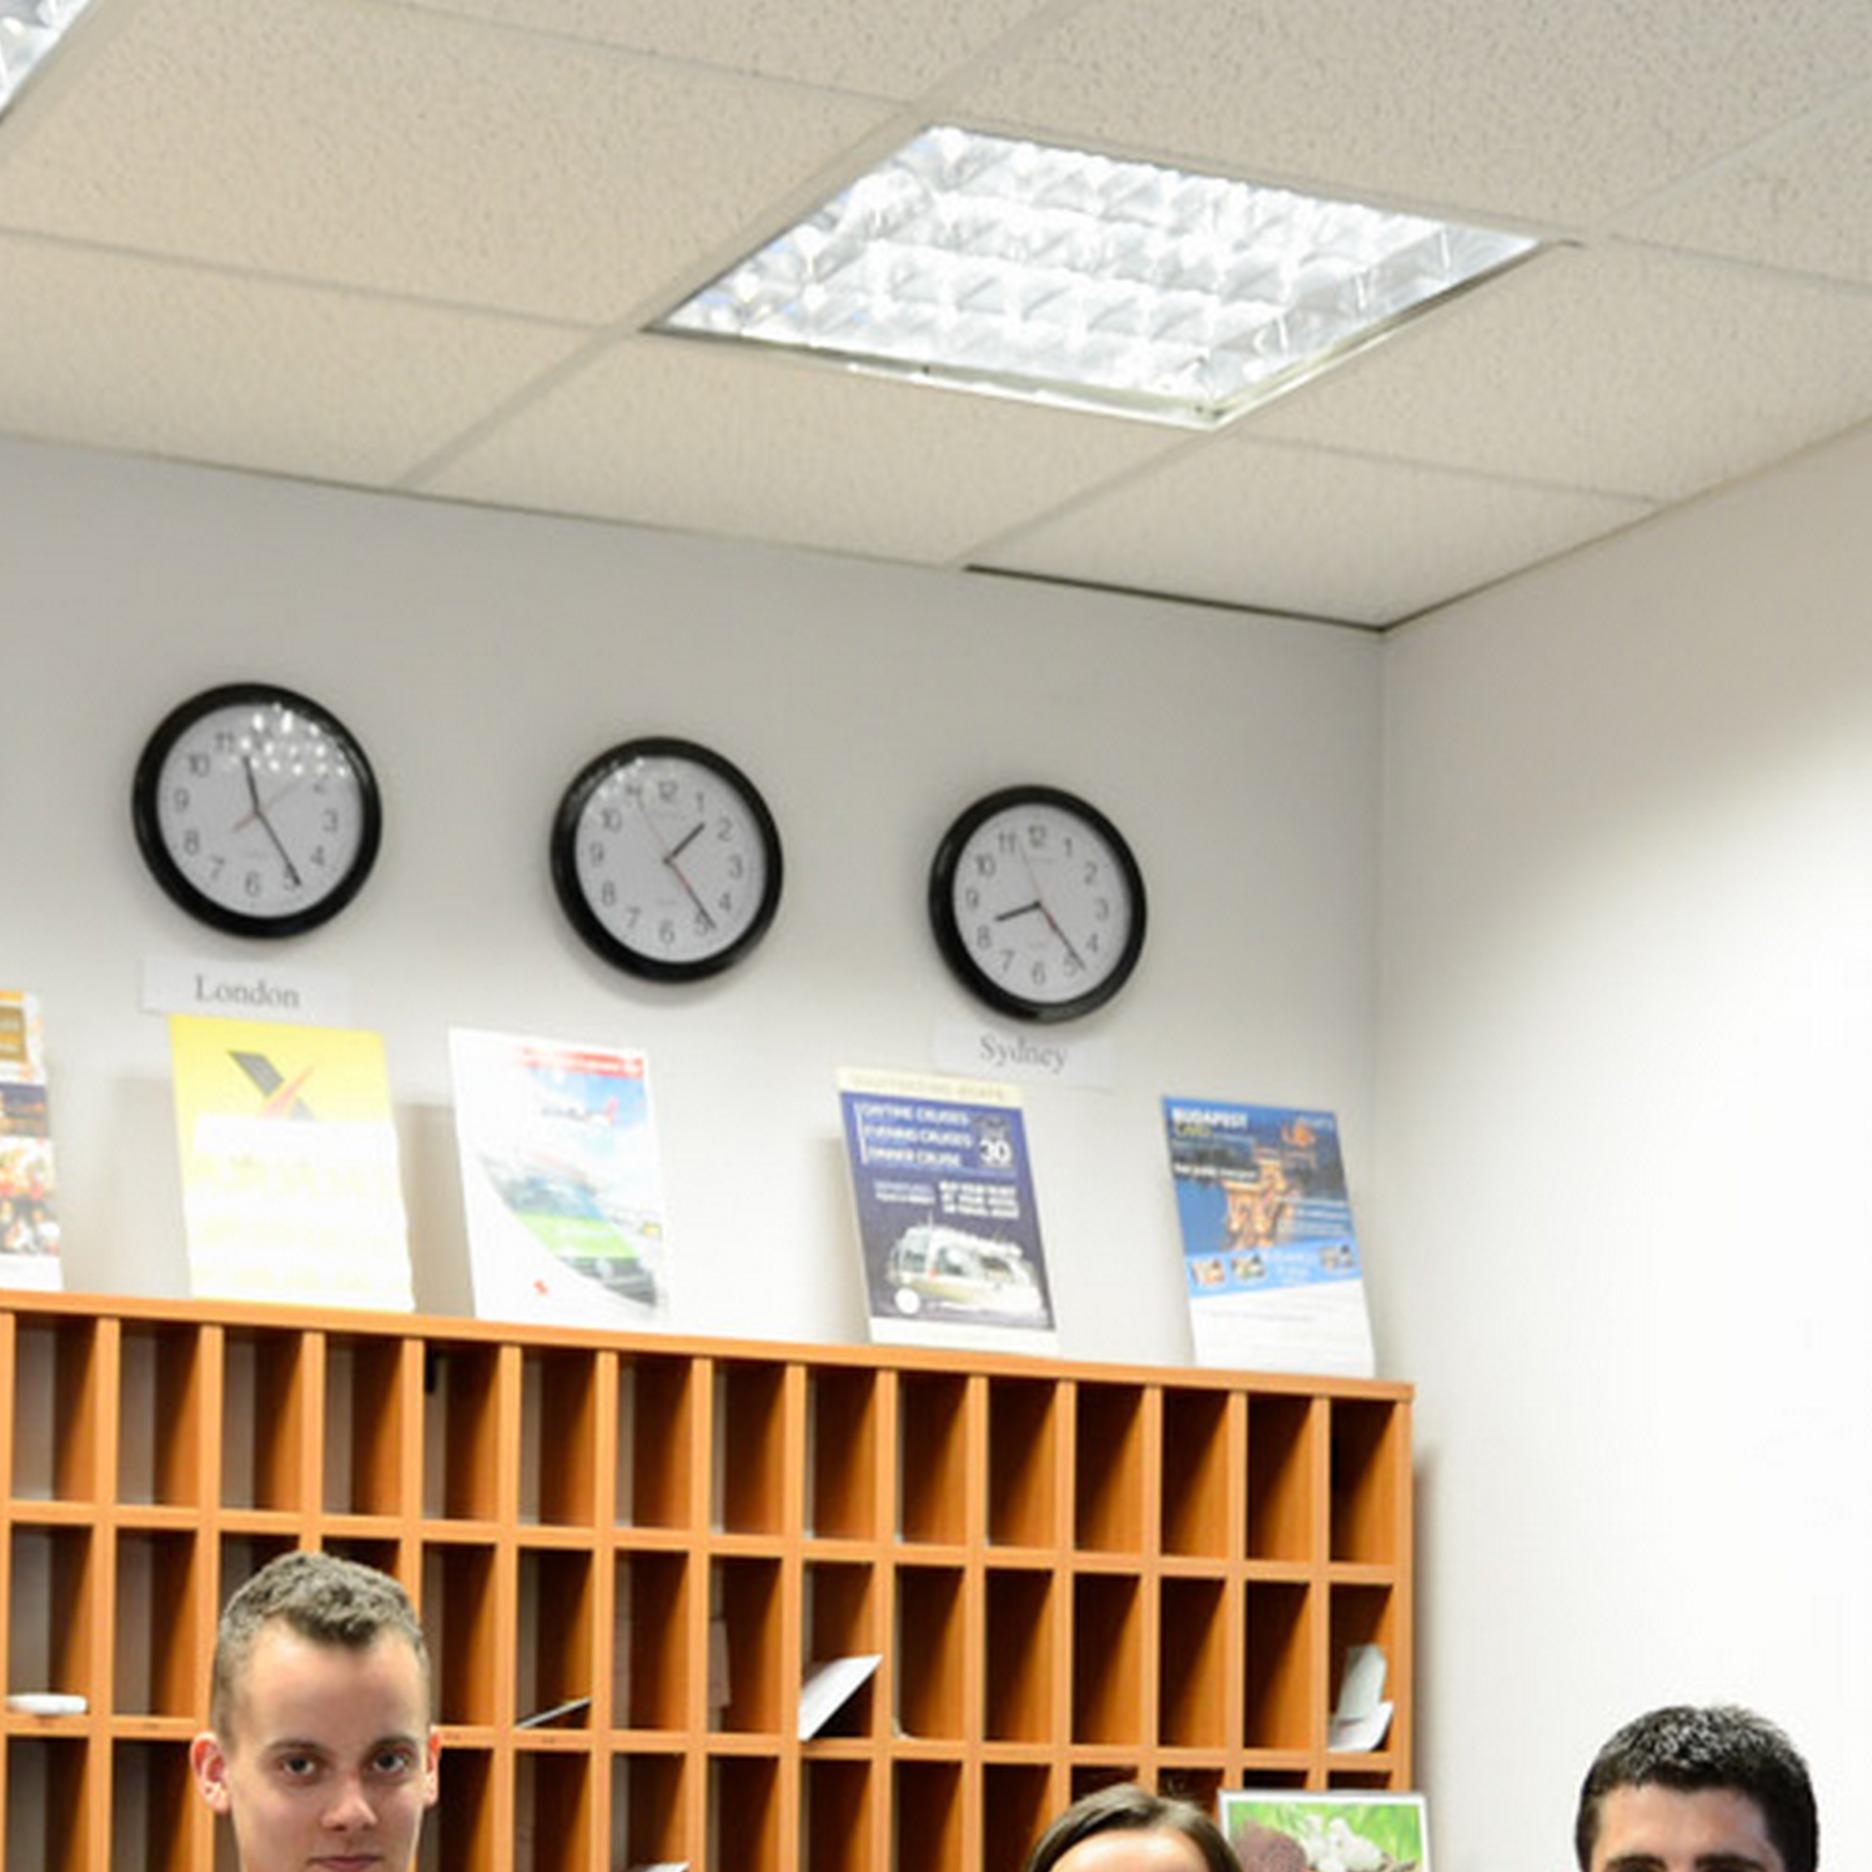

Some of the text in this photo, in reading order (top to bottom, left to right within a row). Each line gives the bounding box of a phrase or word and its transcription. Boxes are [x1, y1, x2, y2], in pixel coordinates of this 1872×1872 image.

[188, 753, 210, 779] 10
[173, 788, 190, 814] 9
[657, 779, 678, 803] 12
[323, 808, 339, 834] 3
[601, 807, 623, 833] 10
[718, 816, 733, 842] 2
[184, 829, 201, 857] 8
[997, 830, 1017, 854] 11
[1027, 824, 1048, 848] 12
[309, 844, 326, 868] 4
[589, 842, 605, 868] 9
[729, 853, 744, 880] 3
[975, 853, 997, 878] 10
[210, 856, 226, 881] 7
[1084, 860, 1099, 886] 2
[244, 871, 261, 898] 6
[601, 880, 617, 908] 8
[718, 892, 732, 912] 4
[965, 887, 979, 912] 9
[1096, 898, 1110, 923] 3
[626, 904, 642, 930] 7
[659, 918, 676, 945] 6
[977, 924, 993, 952] 8
[1085, 930, 1100, 954] 4
[999, 947, 1016, 973] 7
[1031, 960, 1047, 986] 6
[1062, 950, 1079, 979] 5
[195, 973, 301, 1009] London
[978, 1029, 1069, 1076] Sydney
[979, 1138, 1013, 1164] 30
